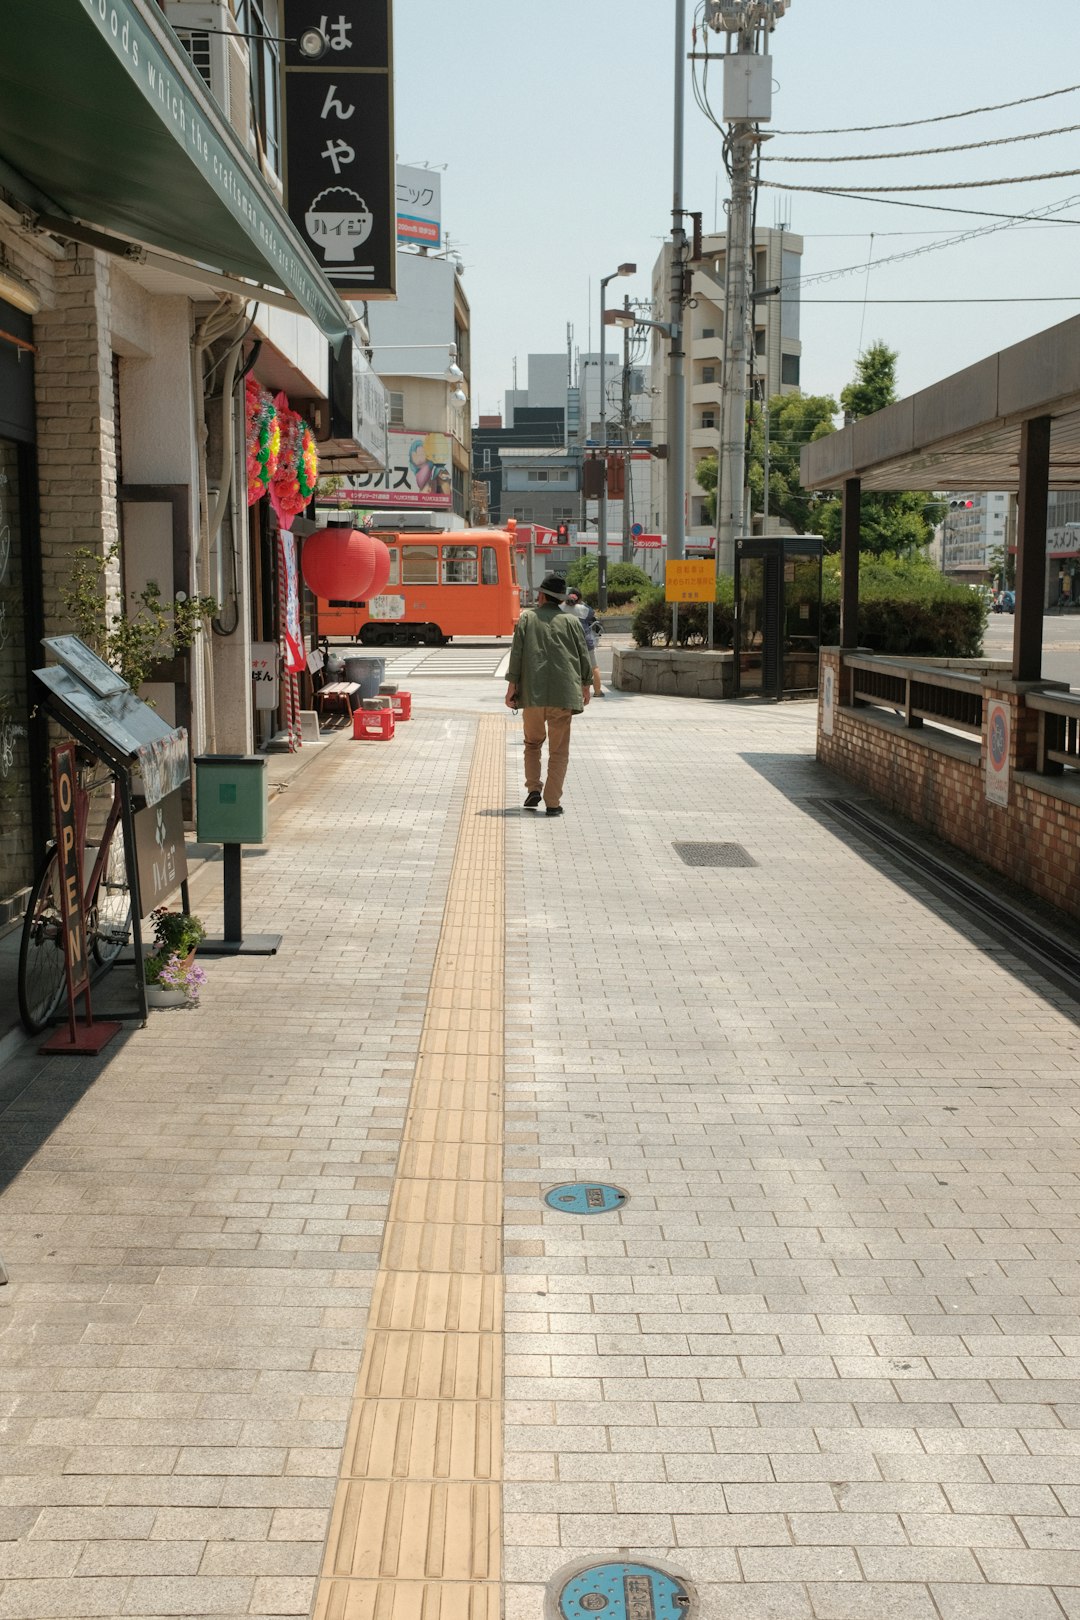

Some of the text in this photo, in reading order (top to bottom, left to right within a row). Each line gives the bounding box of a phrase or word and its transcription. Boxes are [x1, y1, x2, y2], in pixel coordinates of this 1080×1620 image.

[89, 0, 139, 67] oods
[147, 60, 186, 131] which
[191, 118, 208, 161] the
[213, 154, 257, 228] craftsman
[260, 220, 276, 255] made
[278, 248, 289, 272] are
[312, 218, 367, 236] ハイジ
[59, 772, 82, 967] OPEN
